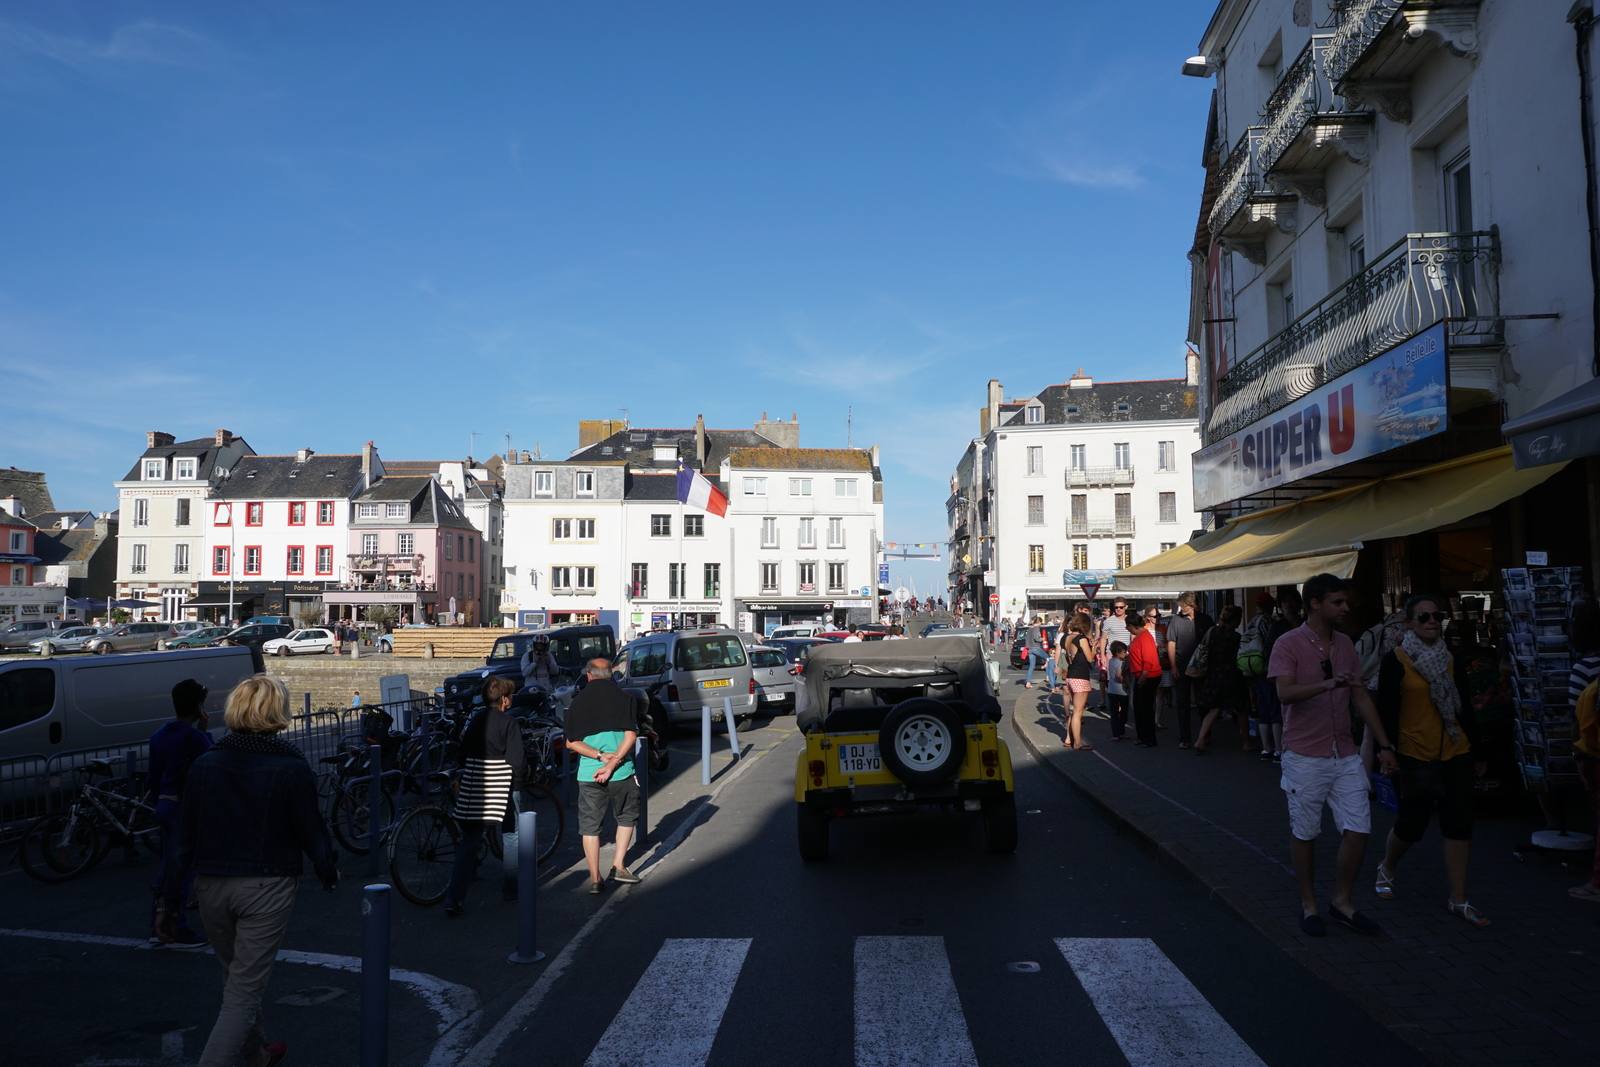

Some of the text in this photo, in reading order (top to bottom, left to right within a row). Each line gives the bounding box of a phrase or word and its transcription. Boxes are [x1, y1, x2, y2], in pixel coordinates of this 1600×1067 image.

[1405, 343, 1425, 366] Belle
[1242, 383, 1355, 487] SUPER U
